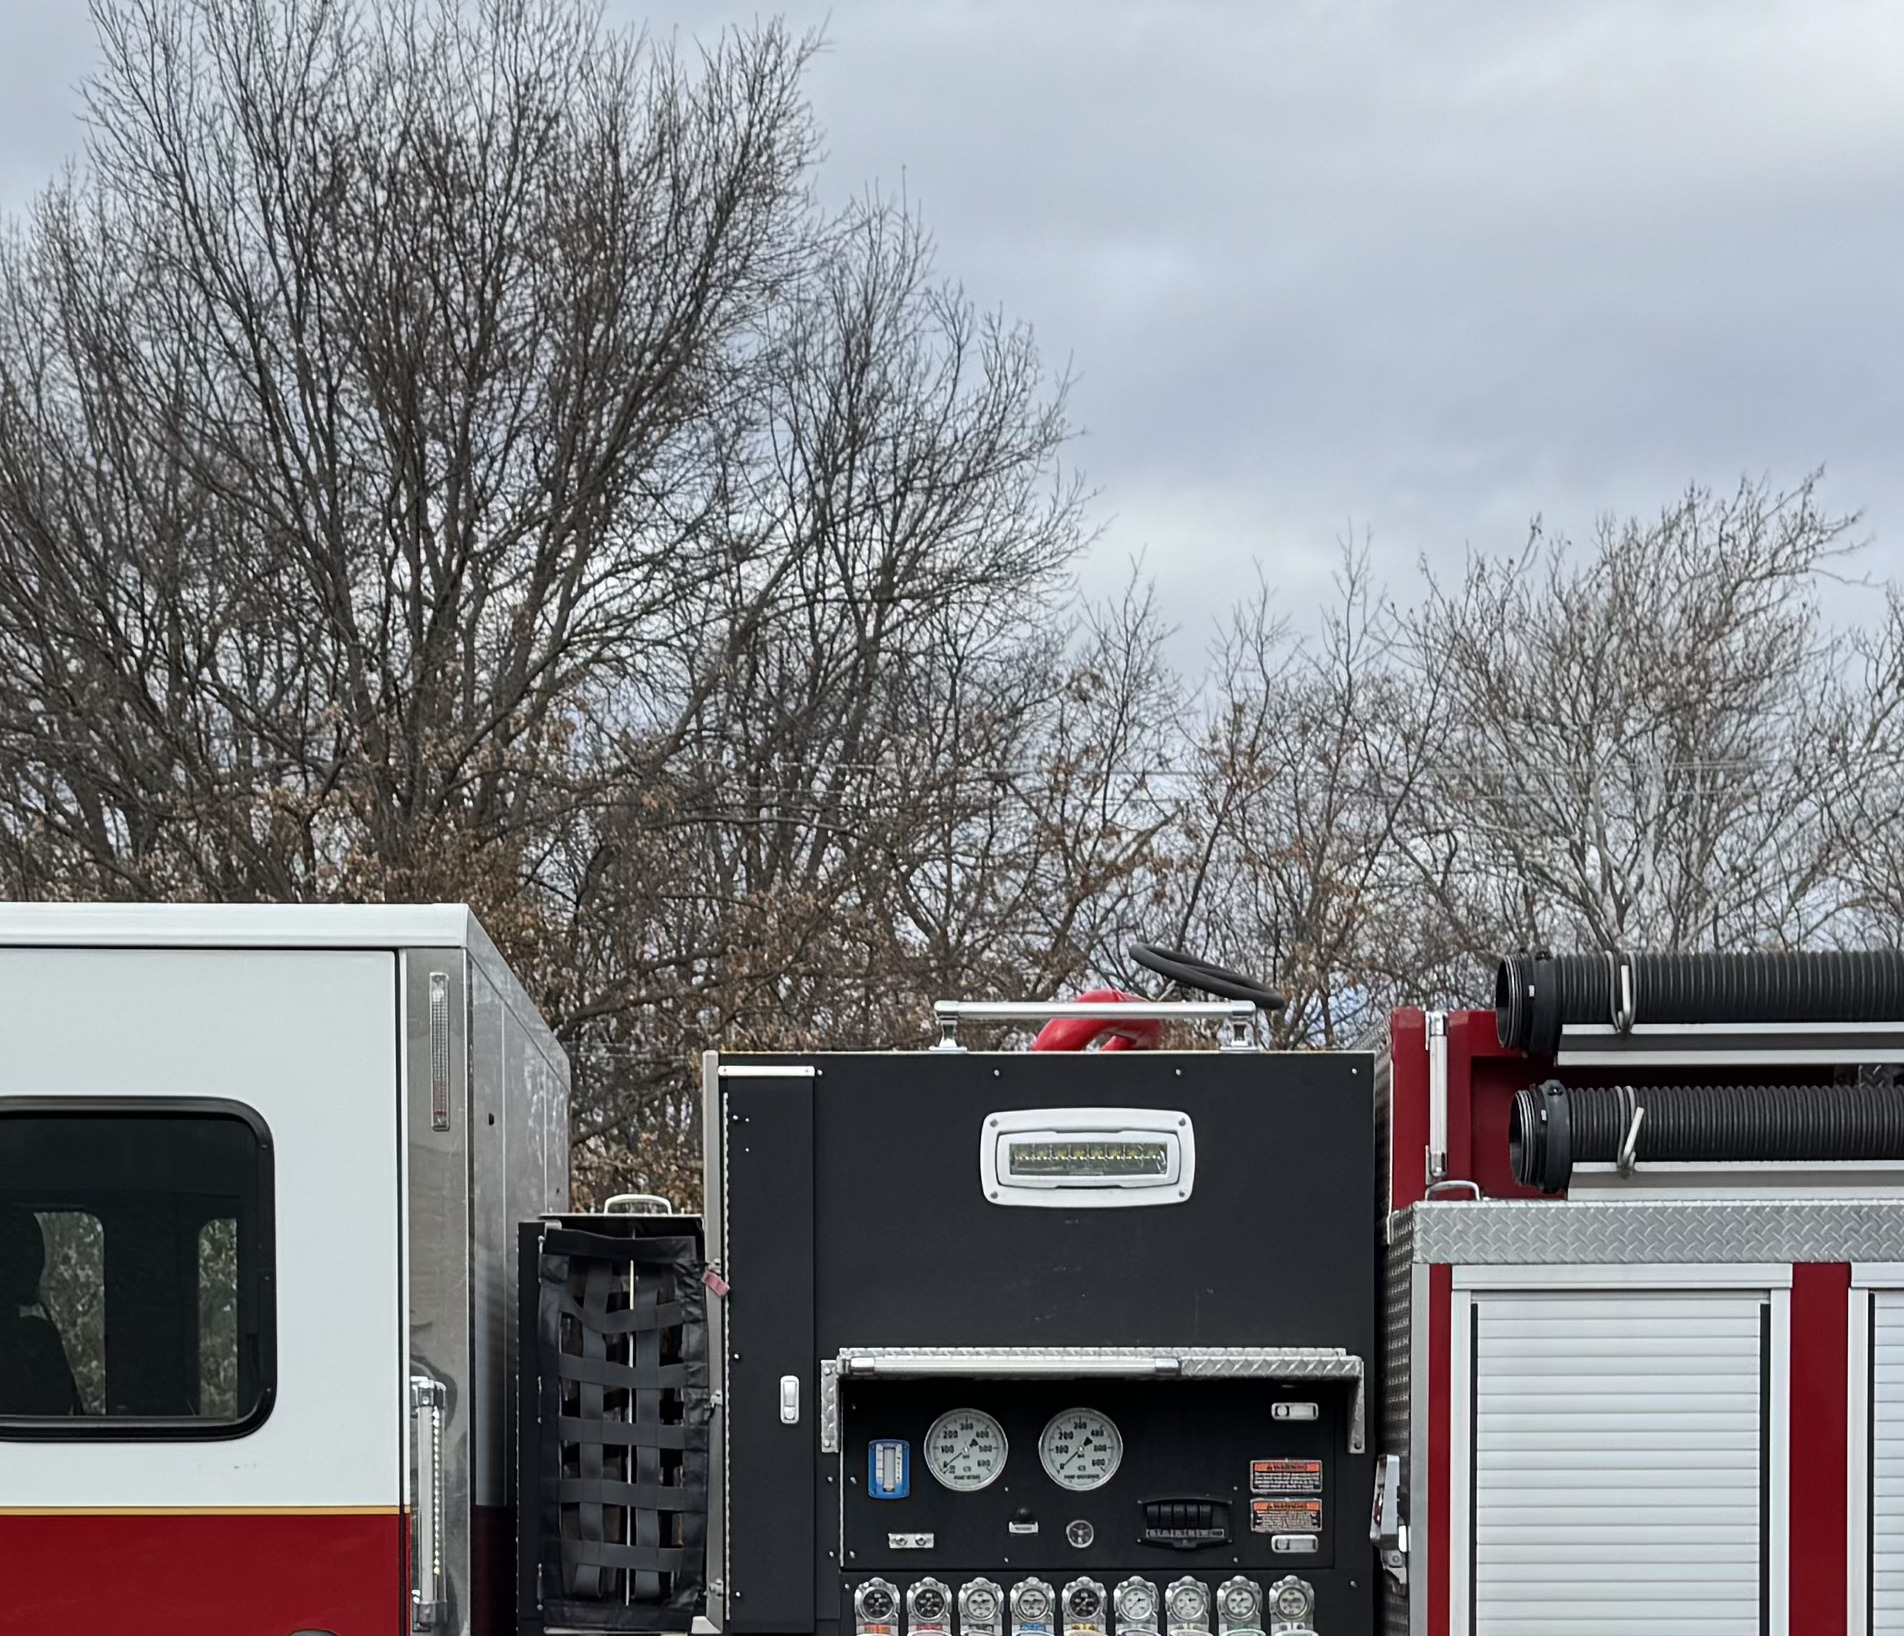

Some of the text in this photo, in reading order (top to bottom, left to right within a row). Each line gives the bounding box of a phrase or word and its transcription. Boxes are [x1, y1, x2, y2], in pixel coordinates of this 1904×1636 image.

[943, 1429, 958, 1440] 200
[1058, 1430, 1074, 1440] 200
[941, 1444, 954, 1454] 100
[1055, 1444, 1069, 1454] 100
